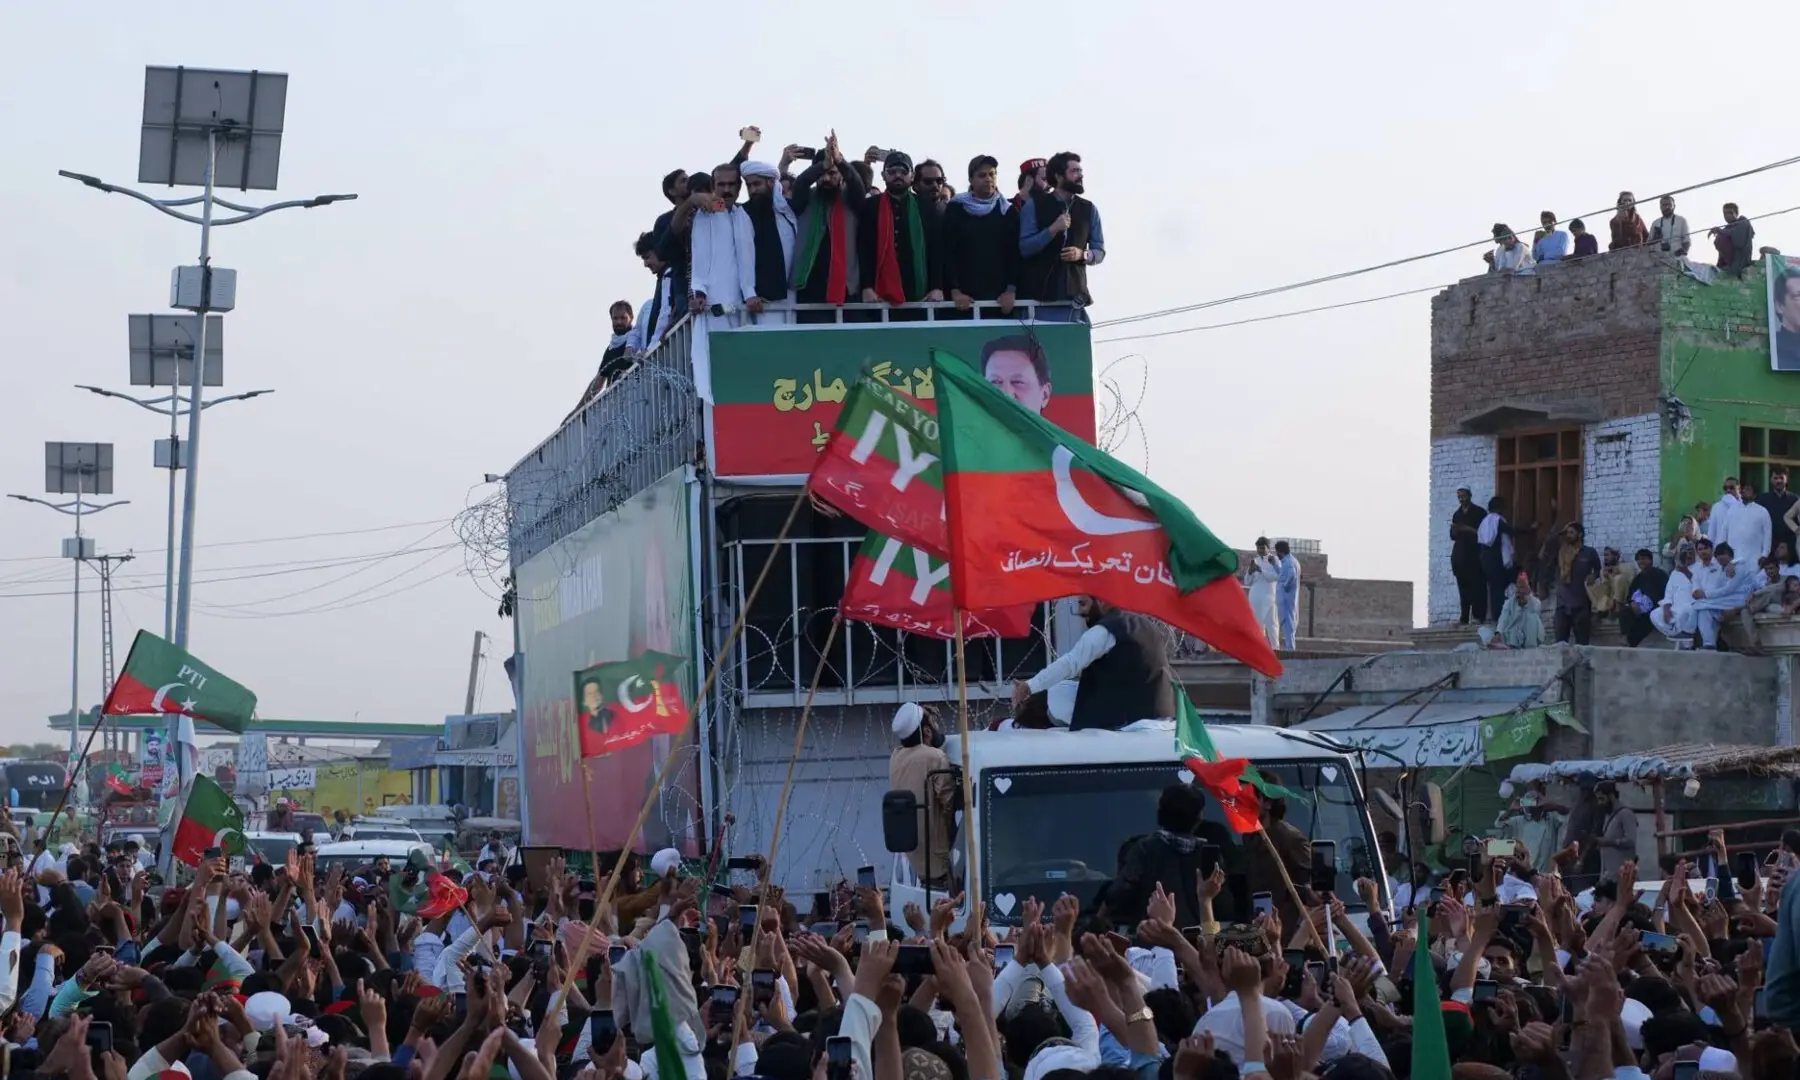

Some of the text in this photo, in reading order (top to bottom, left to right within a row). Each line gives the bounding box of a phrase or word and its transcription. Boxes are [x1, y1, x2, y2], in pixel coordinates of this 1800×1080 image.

[773, 368, 848, 411] مارچ
[850, 409, 941, 493] IY
[1001, 547, 1052, 573] انصاف
[1053, 541, 1133, 575] تحریک
[177, 664, 208, 691] PTI
